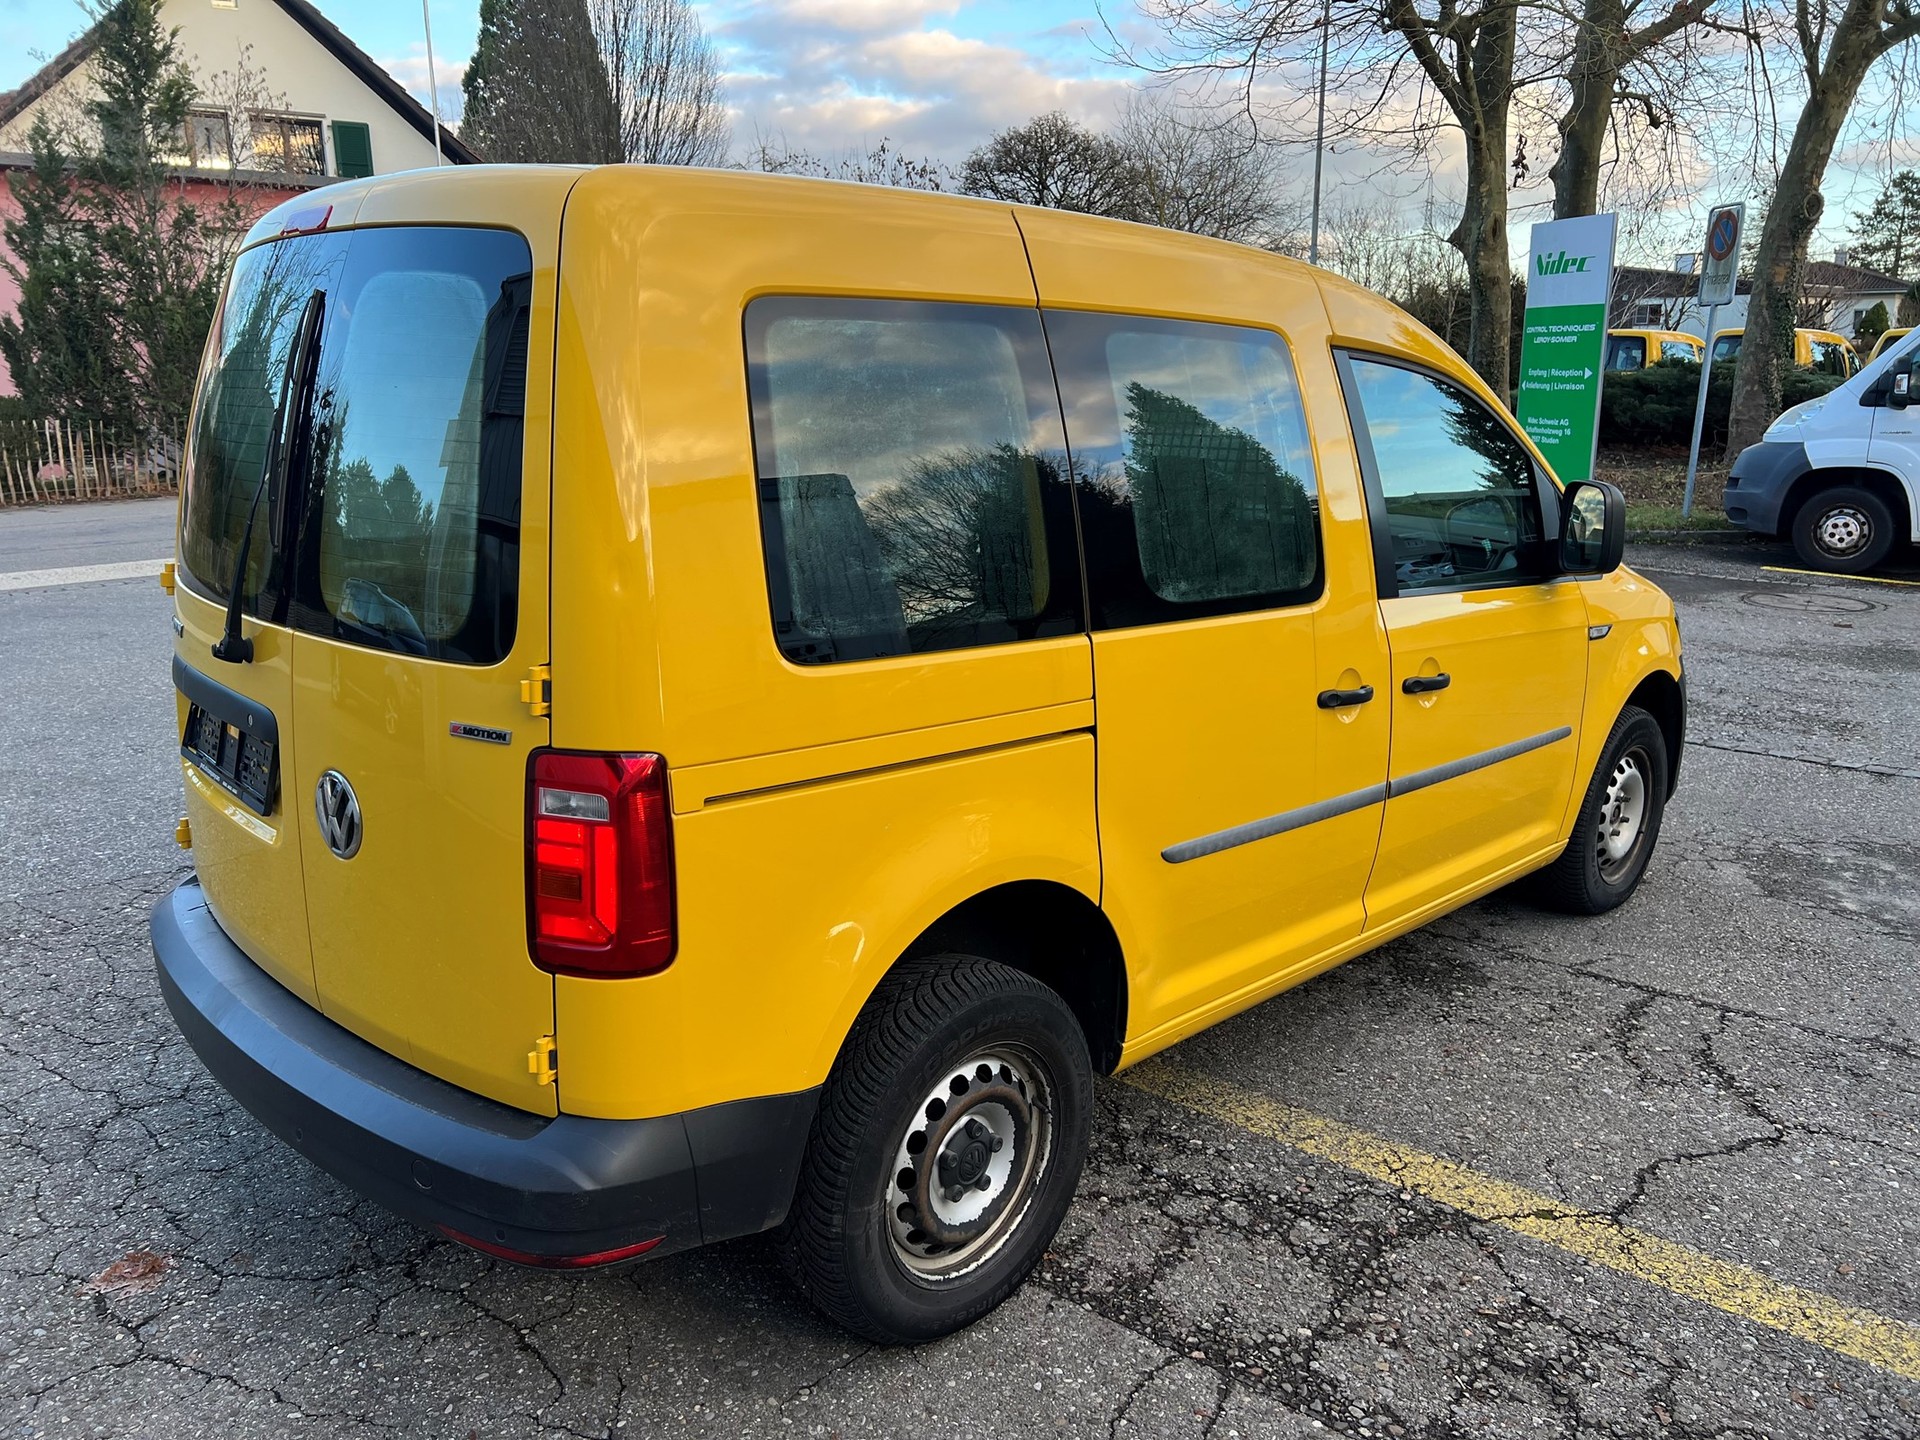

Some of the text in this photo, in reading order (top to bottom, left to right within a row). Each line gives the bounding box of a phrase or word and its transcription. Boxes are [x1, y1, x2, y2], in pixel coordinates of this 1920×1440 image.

[1536, 250, 1596, 276] Nidec
[1526, 323, 1596, 334] CONTROL TECHNIQUES
[1554, 382, 1585, 391] Livraison
[1539, 417, 1559, 426] Schweiz
[1559, 418, 1569, 426] AG
[1564, 428, 1571, 436] 16
[1541, 435, 1560, 445] Studen
